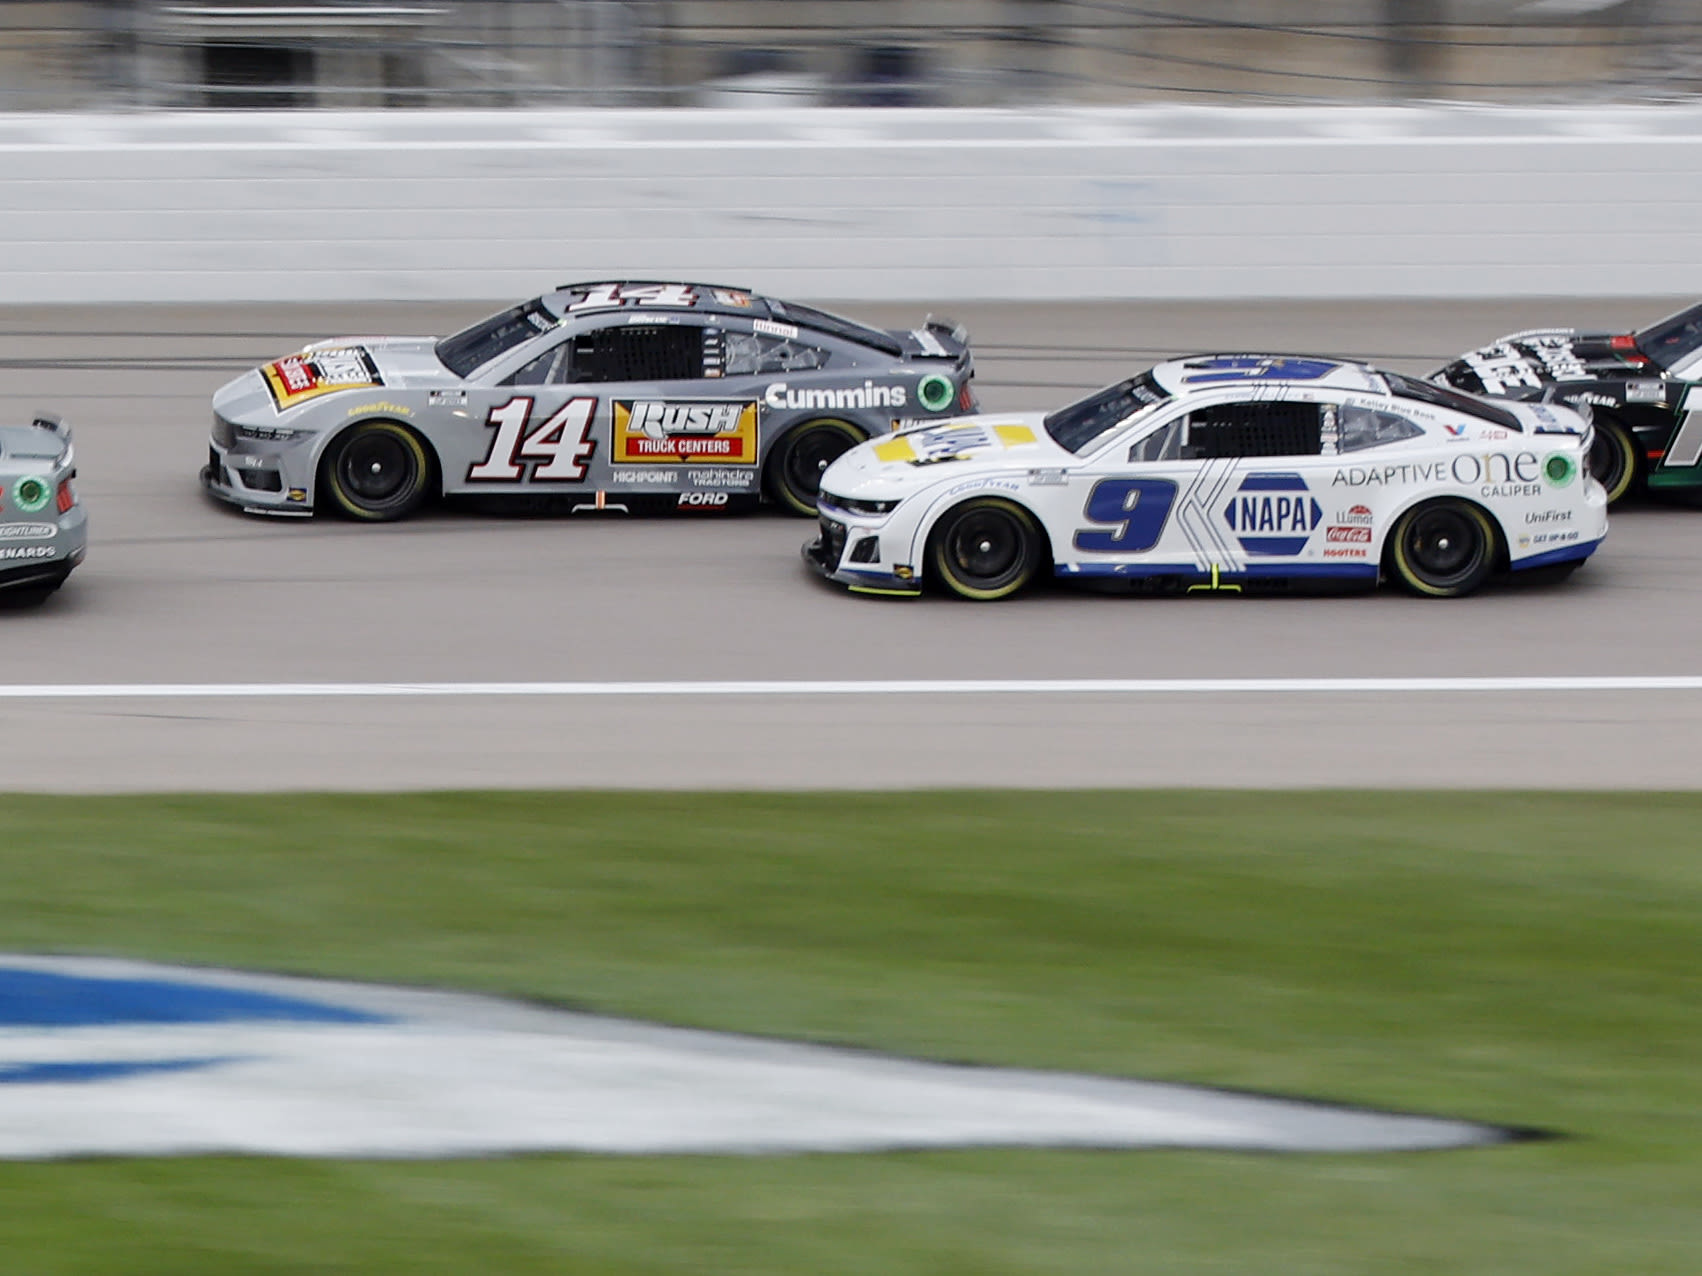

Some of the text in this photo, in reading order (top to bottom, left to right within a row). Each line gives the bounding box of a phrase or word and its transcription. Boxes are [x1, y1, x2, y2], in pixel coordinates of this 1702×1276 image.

[568, 284, 699, 312] 14
[765, 380, 906, 409] Cummins
[348, 401, 410, 416] GOODYEAR
[1360, 398, 1391, 411] Kelley
[627, 400, 744, 438] RUSH
[466, 396, 599, 484] 14
[638, 440, 730, 454] TRUCK CENTERS
[613, 471, 674, 482] HIGHPOINT
[687, 468, 754, 481] mahindra
[1332, 464, 1446, 487] ADAPTIVE
[949, 477, 1020, 495] GOODYEAR
[1481, 485, 1542, 497] CALIPER
[678, 493, 728, 505] FORD
[1073, 477, 1179, 553] 9
[1242, 496, 1307, 531] NAPA
[1336, 511, 1373, 524] LLumar
[1525, 509, 1572, 524] UniFirst
[1323, 549, 1367, 557] HOOTERS
